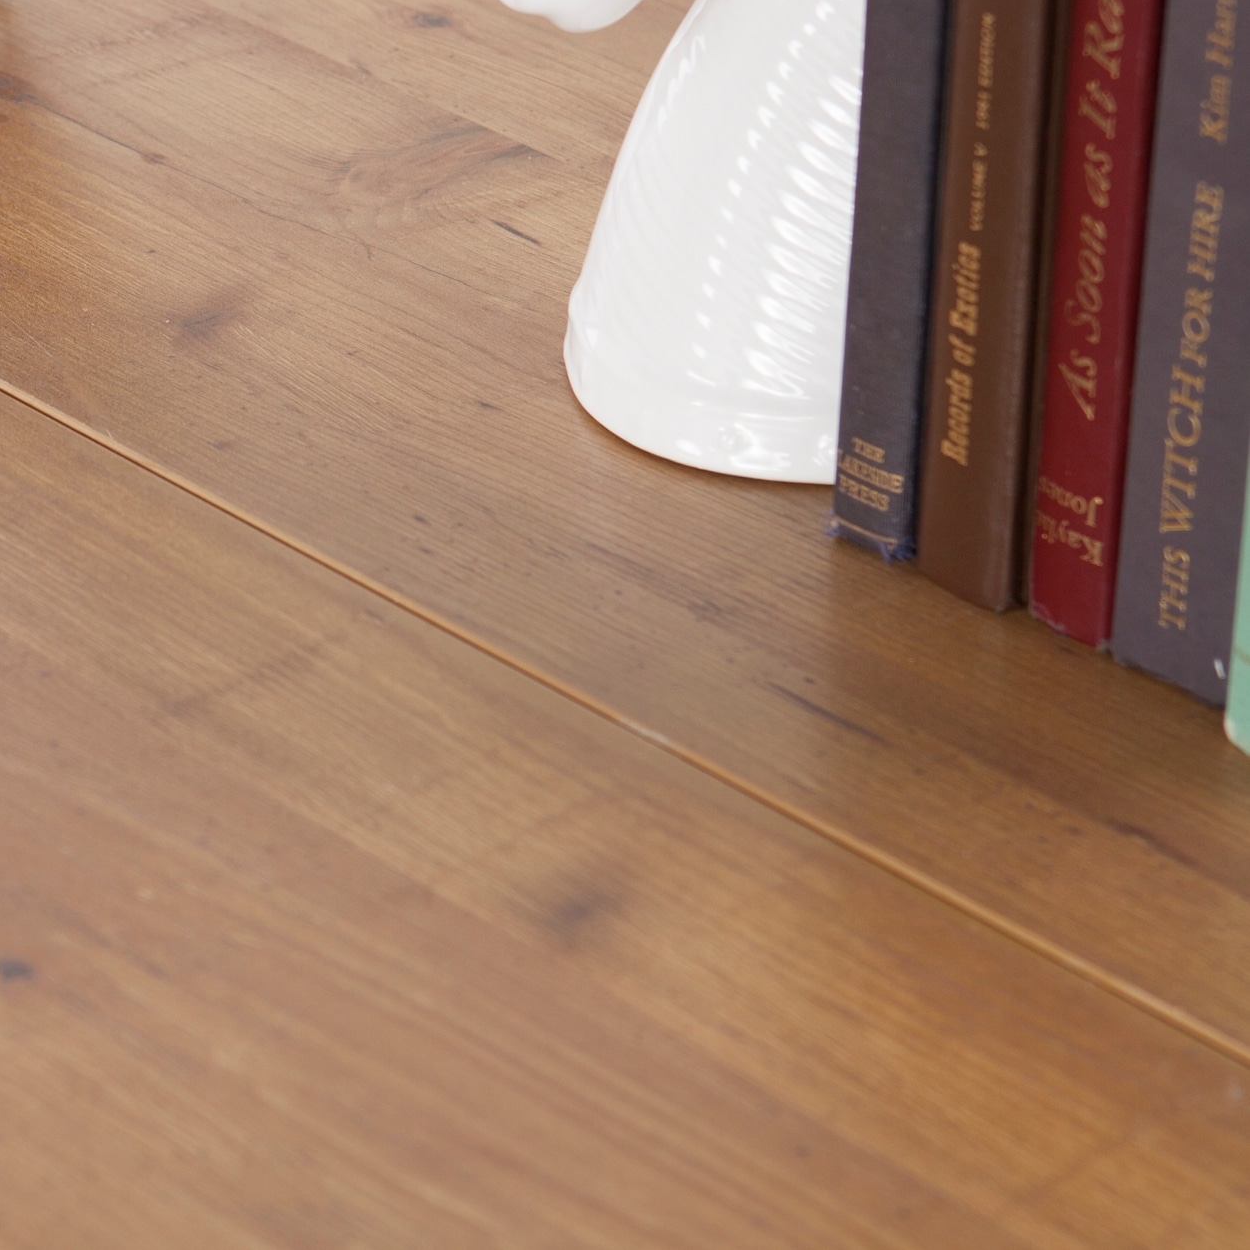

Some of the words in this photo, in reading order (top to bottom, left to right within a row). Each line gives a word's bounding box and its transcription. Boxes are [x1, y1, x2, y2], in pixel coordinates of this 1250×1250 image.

[978, 12, 996, 88] EDITION
[1078, 79, 1117, 140] It
[1199, 74, 1232, 146] Kim
[973, 141, 989, 157] V
[1083, 142, 1113, 209] as
[969, 159, 988, 231] VOLUME
[1186, 180, 1225, 282] HIRE
[949, 241, 981, 337] Exotics
[1064, 212, 1108, 345] Soon
[948, 333, 977, 367] of
[1179, 286, 1214, 369] FOR
[941, 368, 972, 467] Records
[1058, 348, 1098, 421] As
[851, 436, 886, 464] THE
[1159, 362, 1206, 534] WITCH
[838, 473, 891, 512] PRESS
[1038, 475, 1104, 528] Jones
[1158, 544, 1191, 630] THIS
